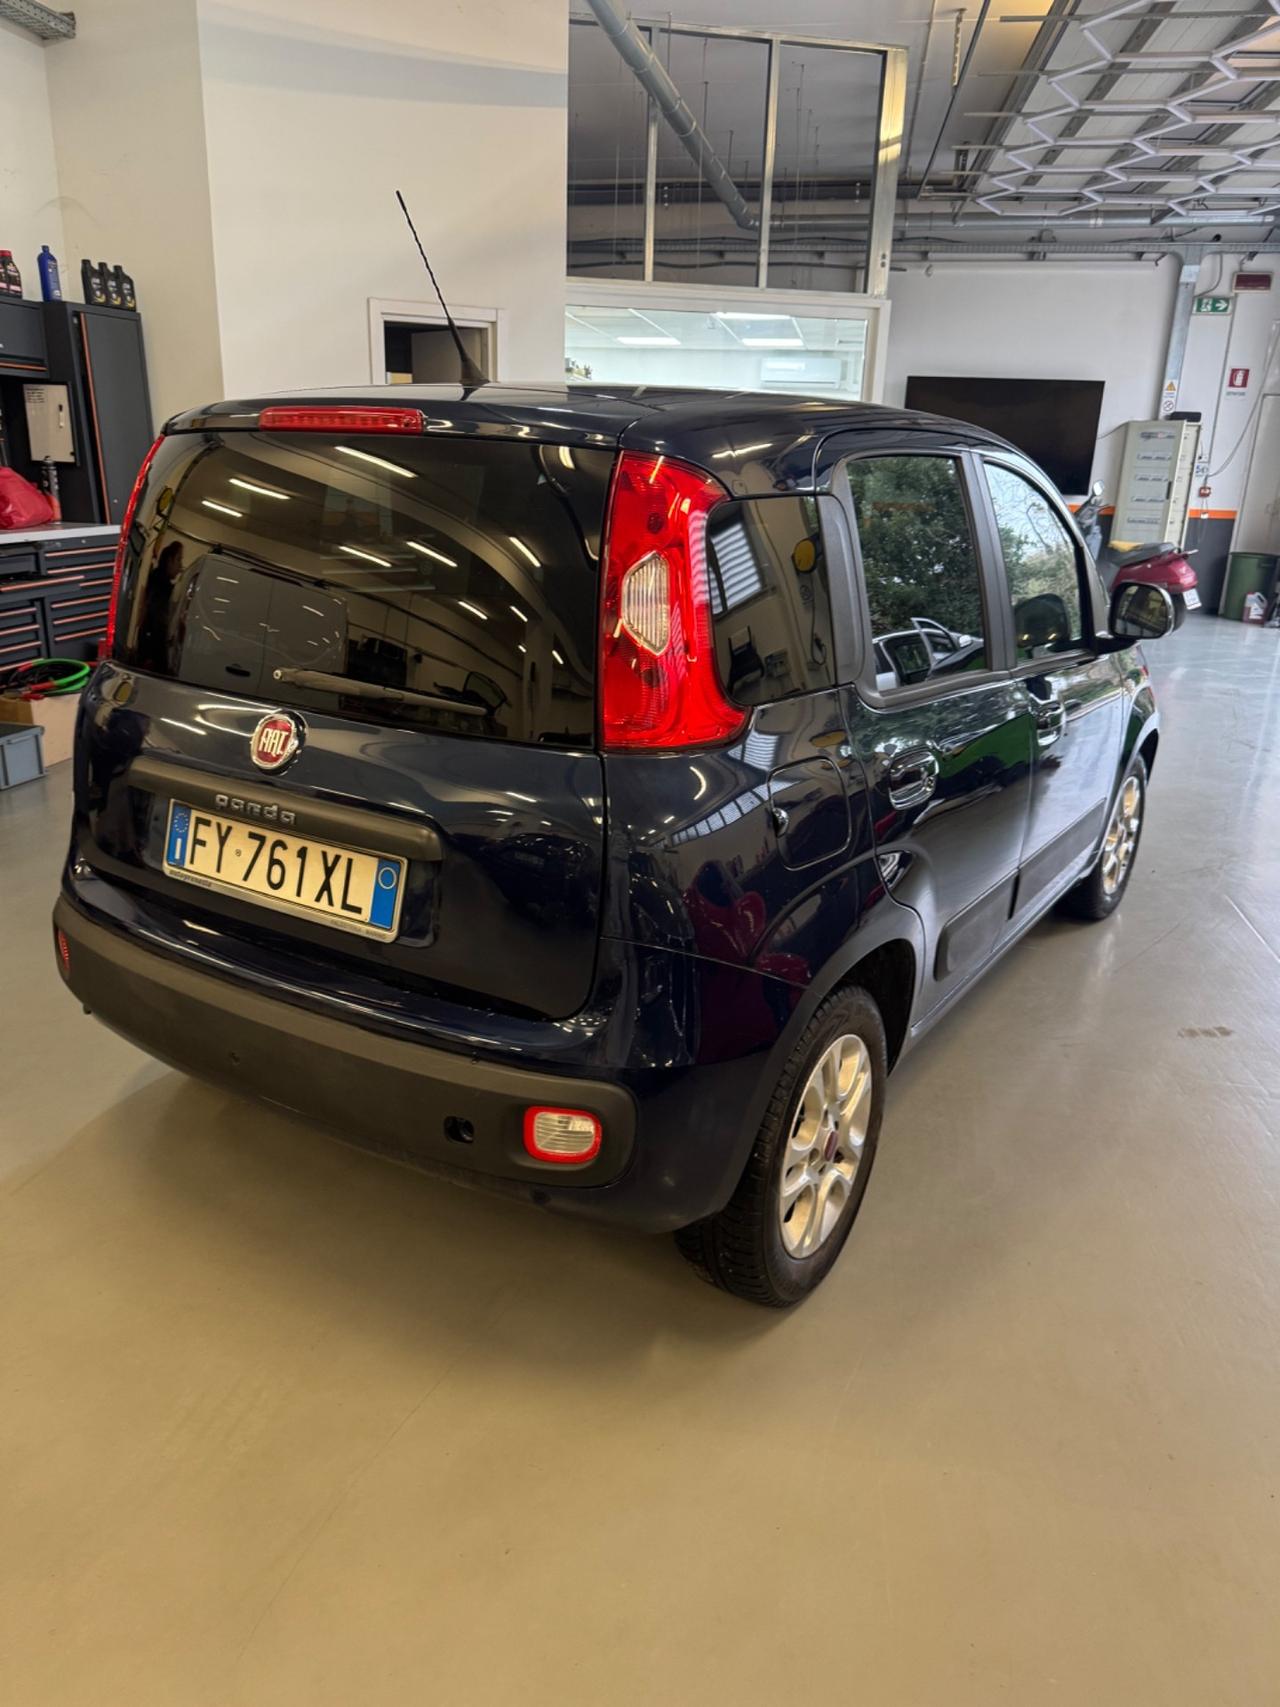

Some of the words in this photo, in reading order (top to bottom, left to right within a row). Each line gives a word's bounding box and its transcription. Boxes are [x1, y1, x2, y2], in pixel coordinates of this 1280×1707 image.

[174, 838, 182, 860] I
[189, 816, 233, 873] FY
[242, 831, 363, 915] 761XL
